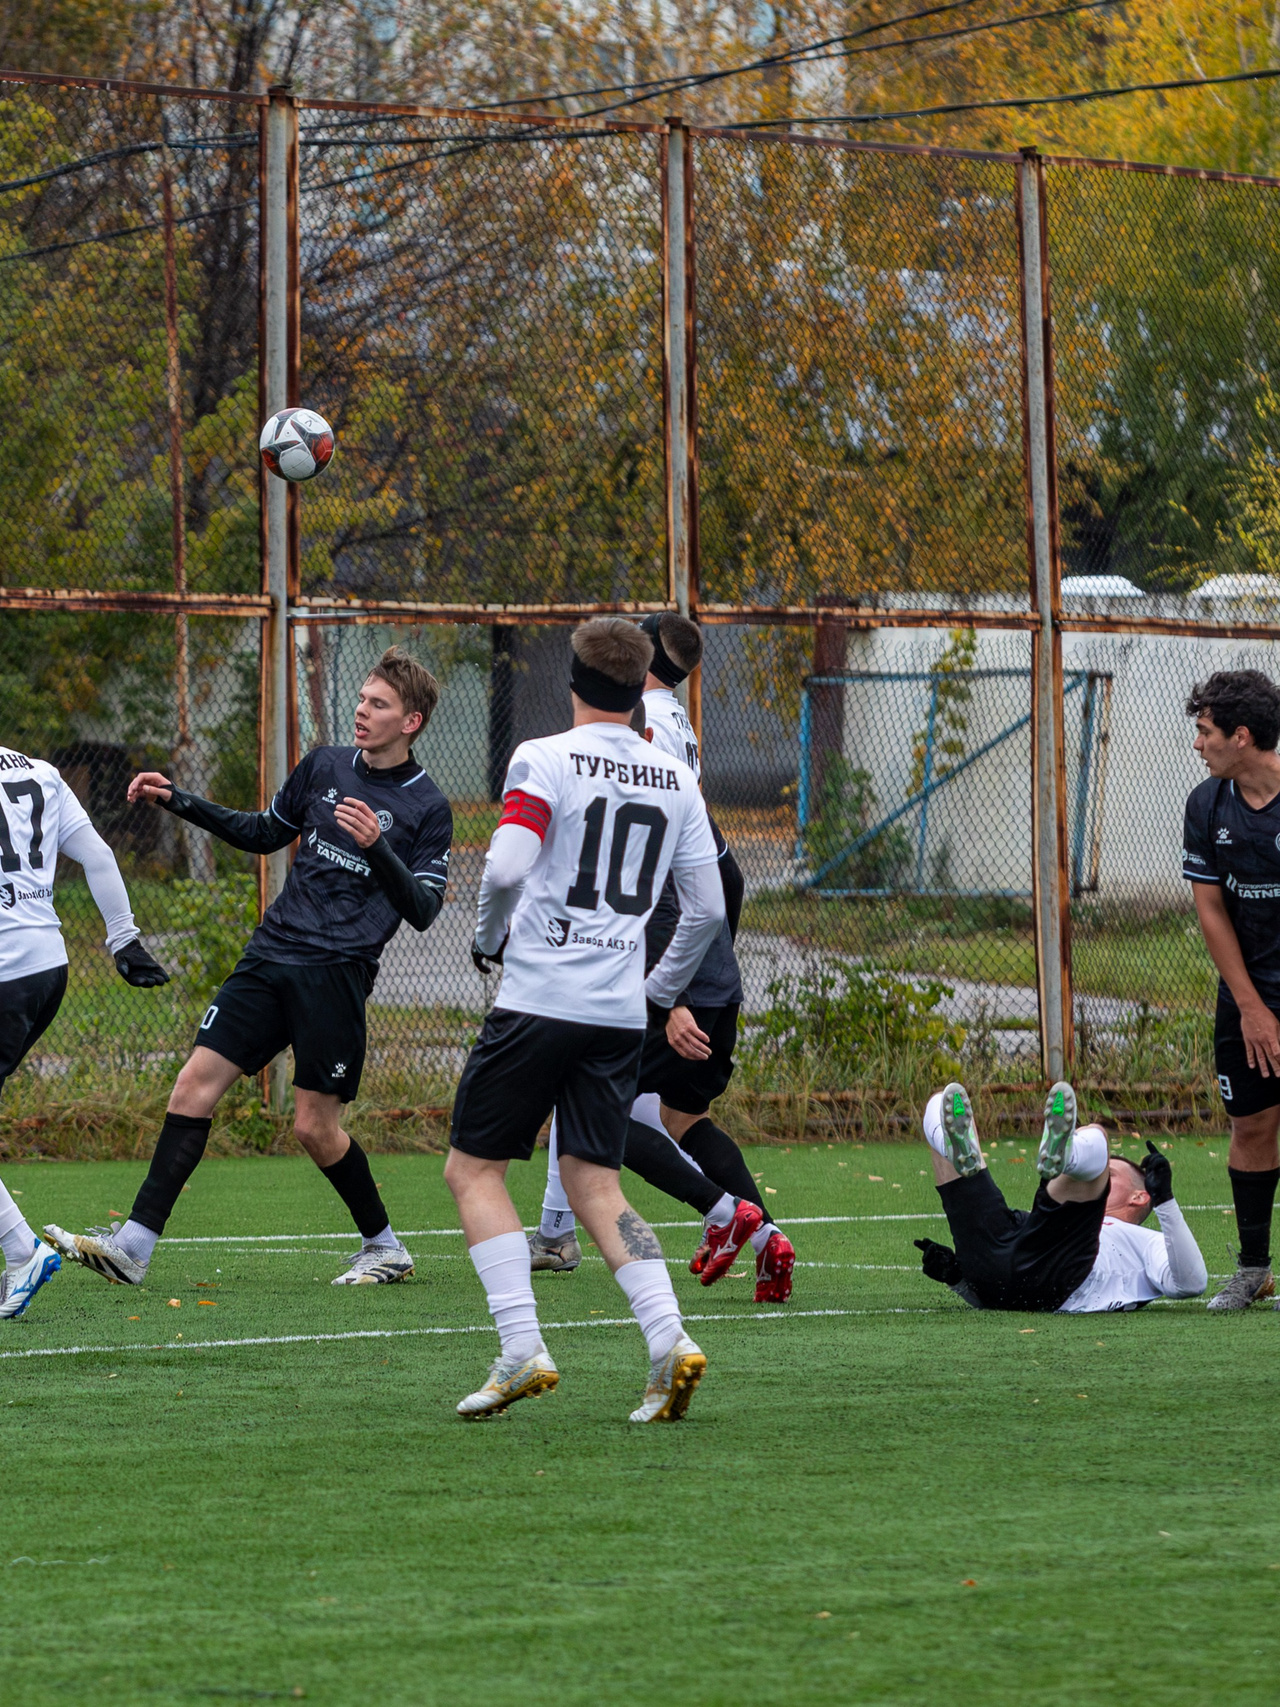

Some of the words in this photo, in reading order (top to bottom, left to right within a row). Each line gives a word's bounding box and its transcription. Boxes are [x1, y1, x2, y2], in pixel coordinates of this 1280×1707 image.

[570, 752, 680, 791] ТУРБИНА
[316, 843, 371, 877] TATNEFT
[566, 796, 668, 917] 10
[571, 932, 604, 949] Завод
[606, 937, 625, 950] АКЗ
